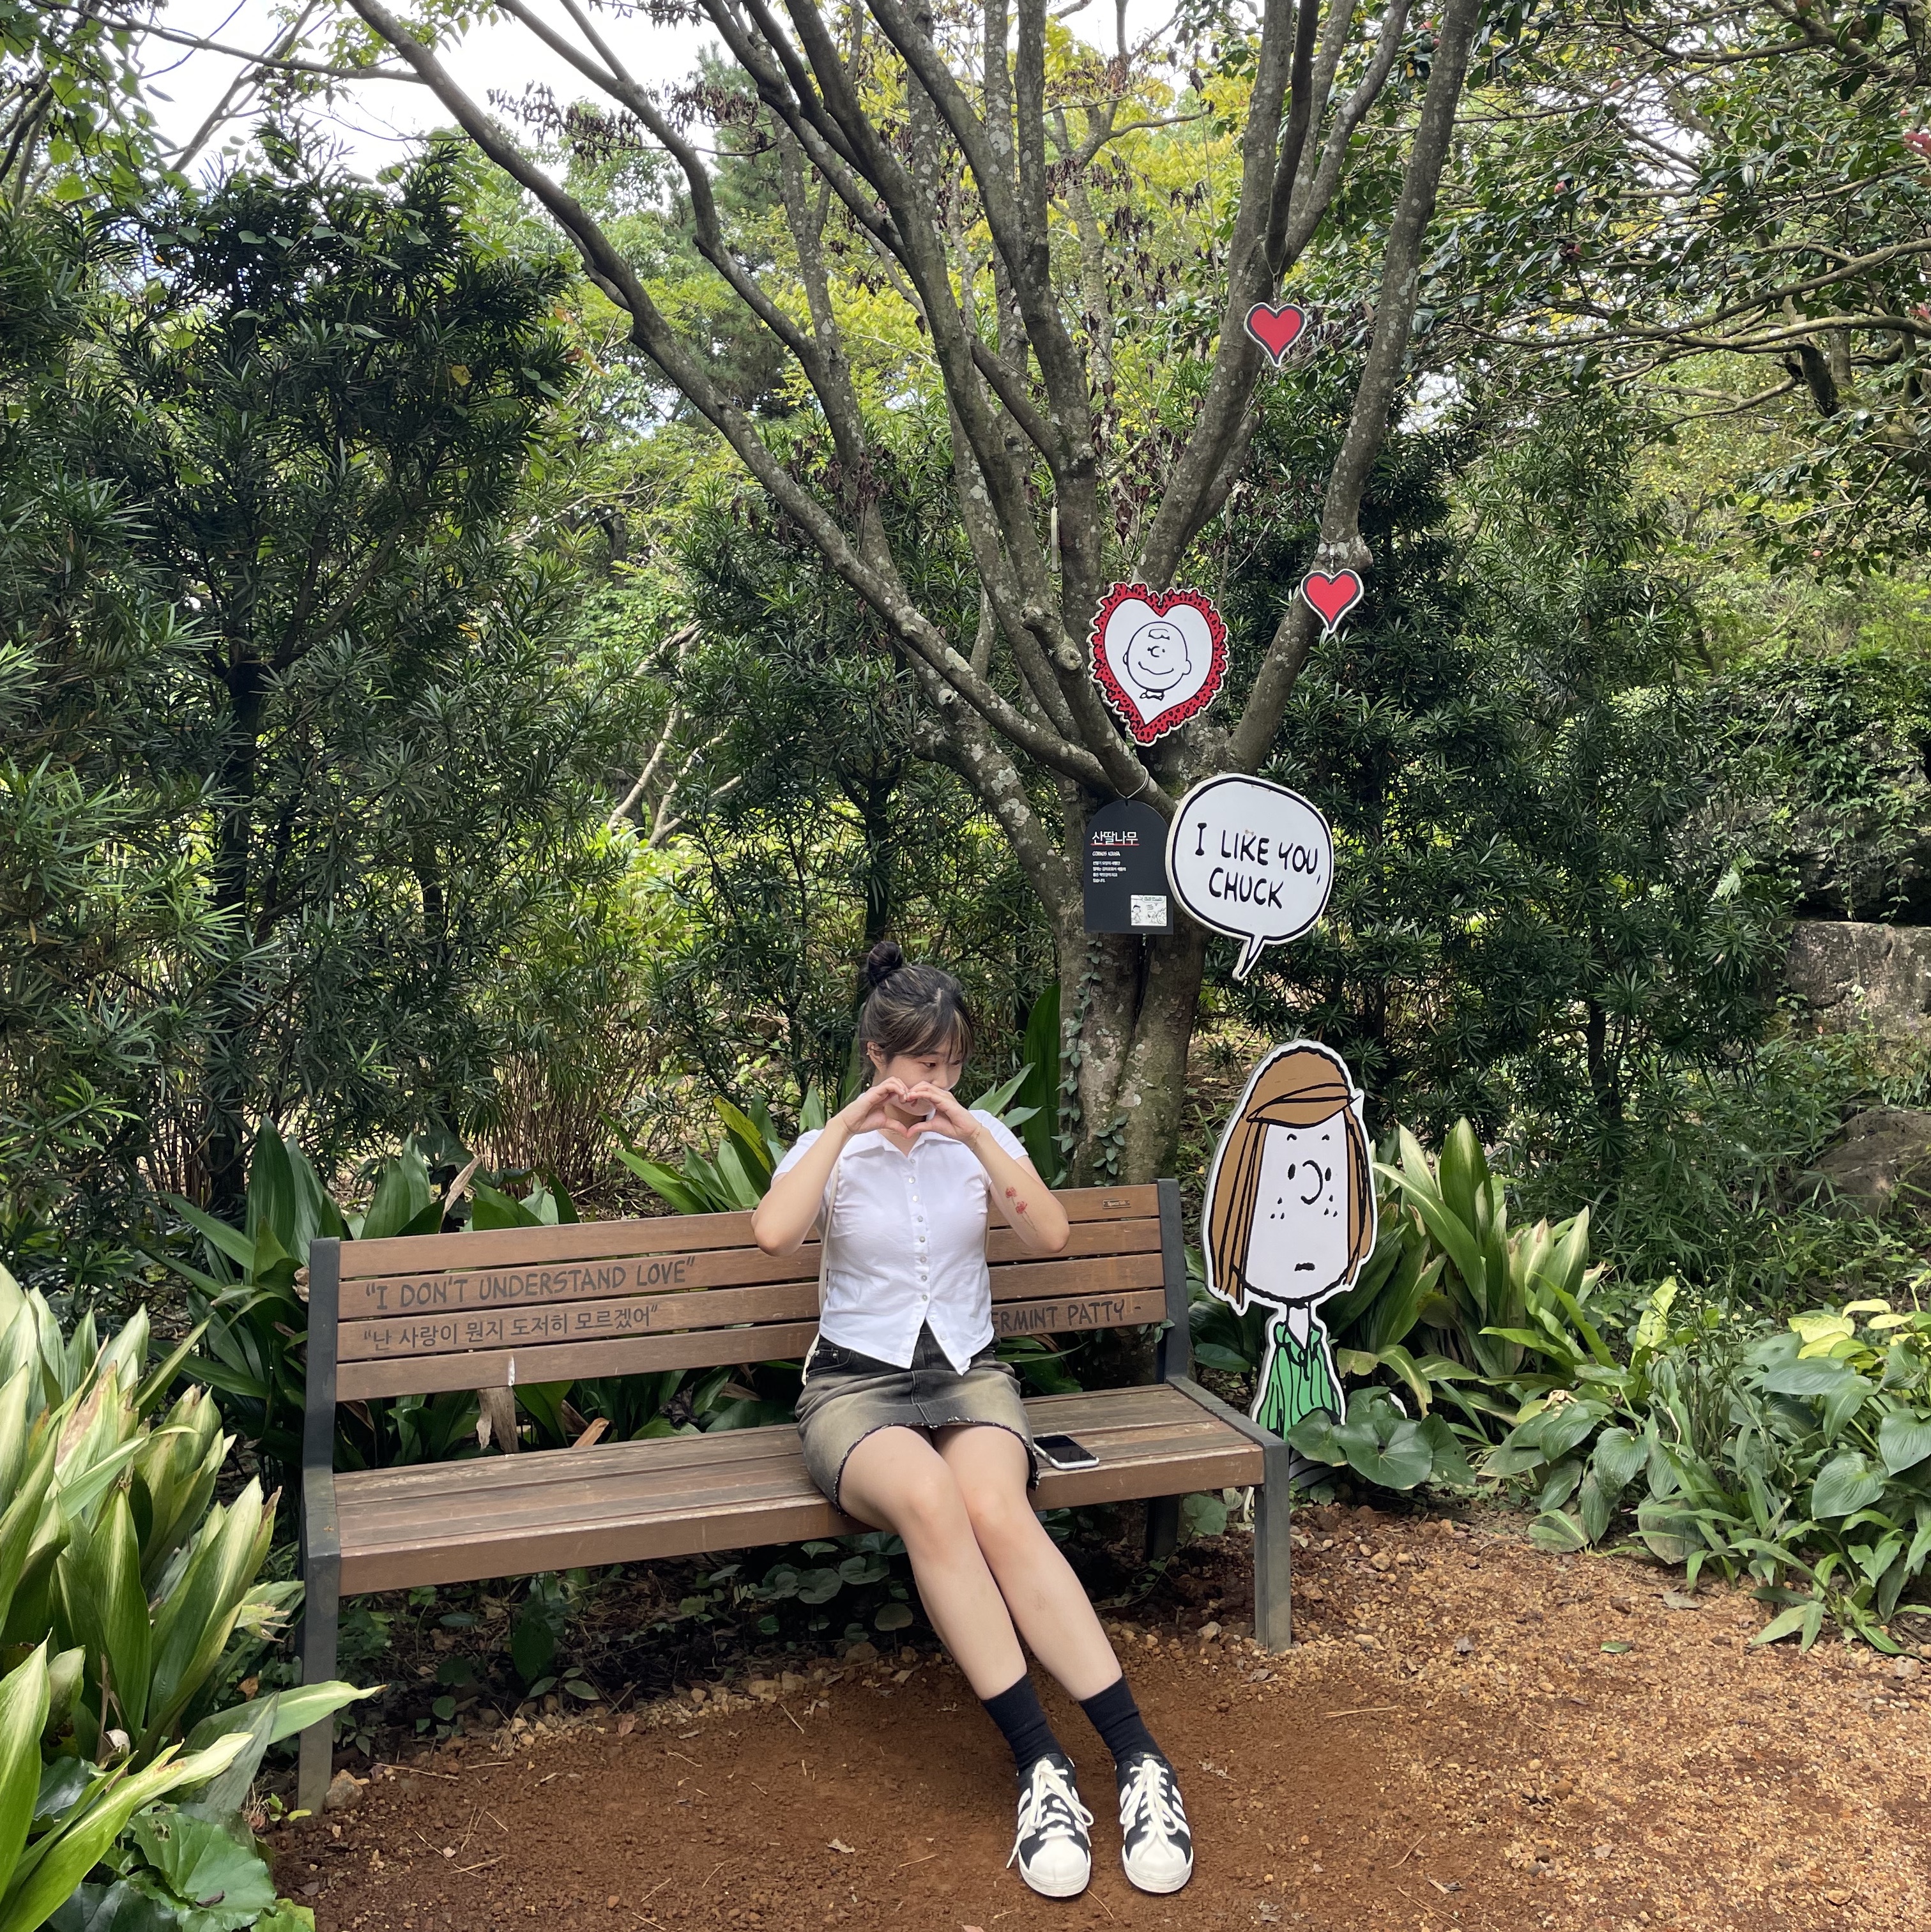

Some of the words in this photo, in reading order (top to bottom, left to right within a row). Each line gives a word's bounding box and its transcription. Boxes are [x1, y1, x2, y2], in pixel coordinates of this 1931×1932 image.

[1092, 830, 1139, 846] 산딸나무
[1194, 822, 1207, 856] I
[1221, 830, 1270, 866] LIKE
[1209, 867, 1284, 909] CHUCK
[400, 1276, 468, 1307] DON'T
[479, 1265, 627, 1301] UNDERSTAND
[636, 1256, 696, 1286] LOVE"
[399, 1323, 457, 1348] 사랑이
[465, 1319, 503, 1343] 뭔지
[510, 1313, 568, 1336] 도저히
[1067, 1298, 1125, 1326] PATTY
